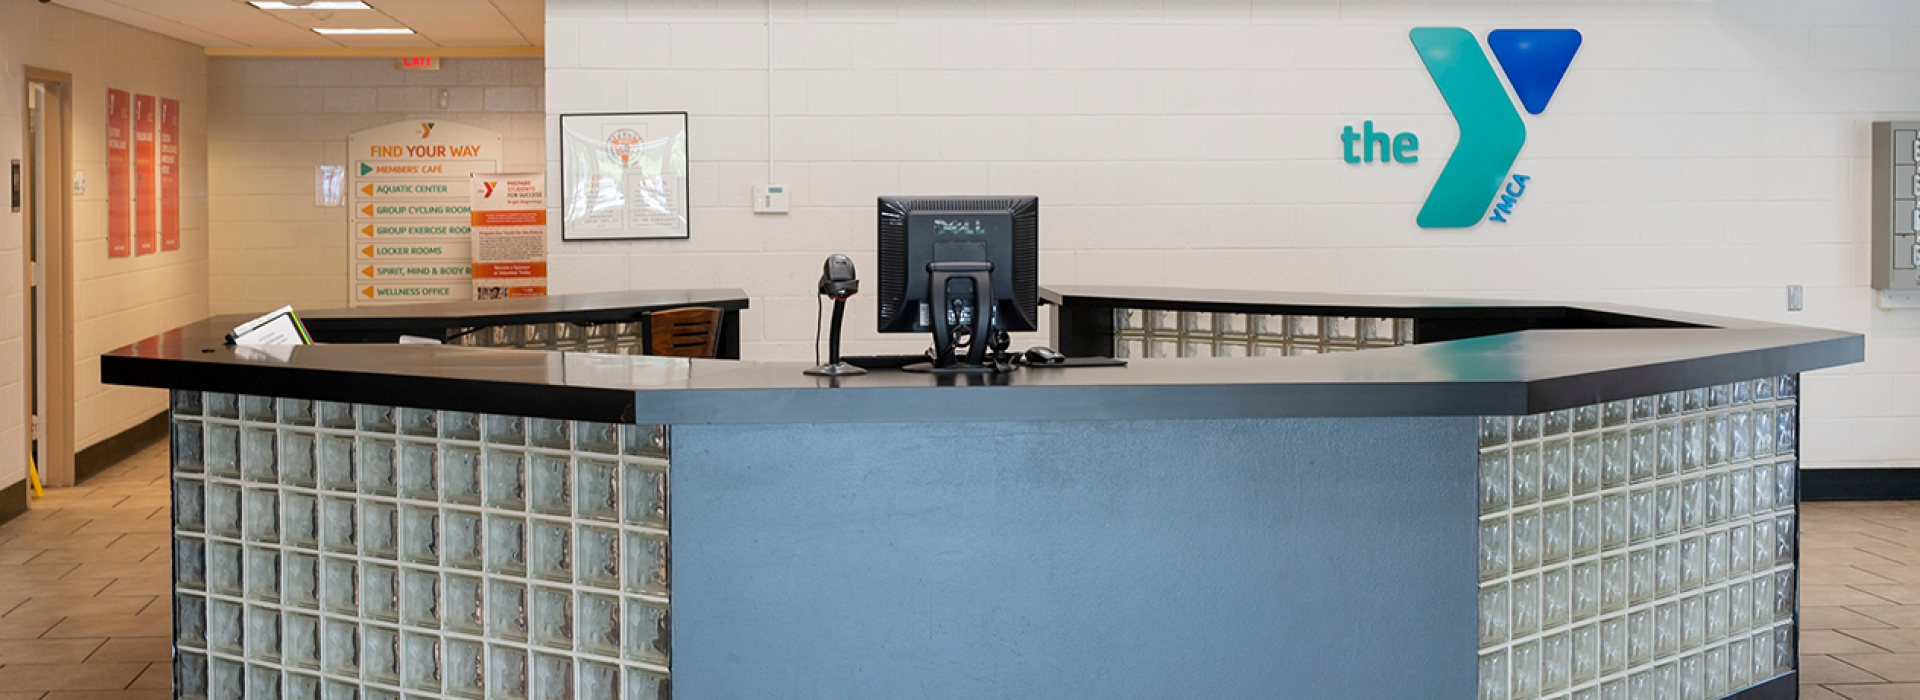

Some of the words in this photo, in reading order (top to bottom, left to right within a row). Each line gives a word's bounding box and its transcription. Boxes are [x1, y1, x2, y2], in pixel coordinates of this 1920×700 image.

[1340, 120, 1419, 164] the
[370, 145, 404, 158] FIND
[406, 145, 447, 158] YOUR
[449, 145, 481, 158] WAY
[421, 163, 443, 174] CAFÉ
[376, 185, 413, 195] AQUATIC
[414, 185, 448, 193] CENTER
[1489, 173, 1531, 223] YMCA
[376, 206, 407, 214] GROUP
[408, 206, 444, 214] CYCLING
[376, 226, 407, 234] GROUP
[408, 226, 448, 234] EXERCISE
[934, 219, 985, 234] DELL
[376, 247, 410, 255] LOCKER
[411, 247, 442, 255] ROOMS
[406, 267, 430, 275] MIND
[431, 267, 439, 275] &
[440, 267, 464, 275] BODY
[376, 287, 421, 296] WELLNESS
[422, 287, 450, 296] OFFICE
